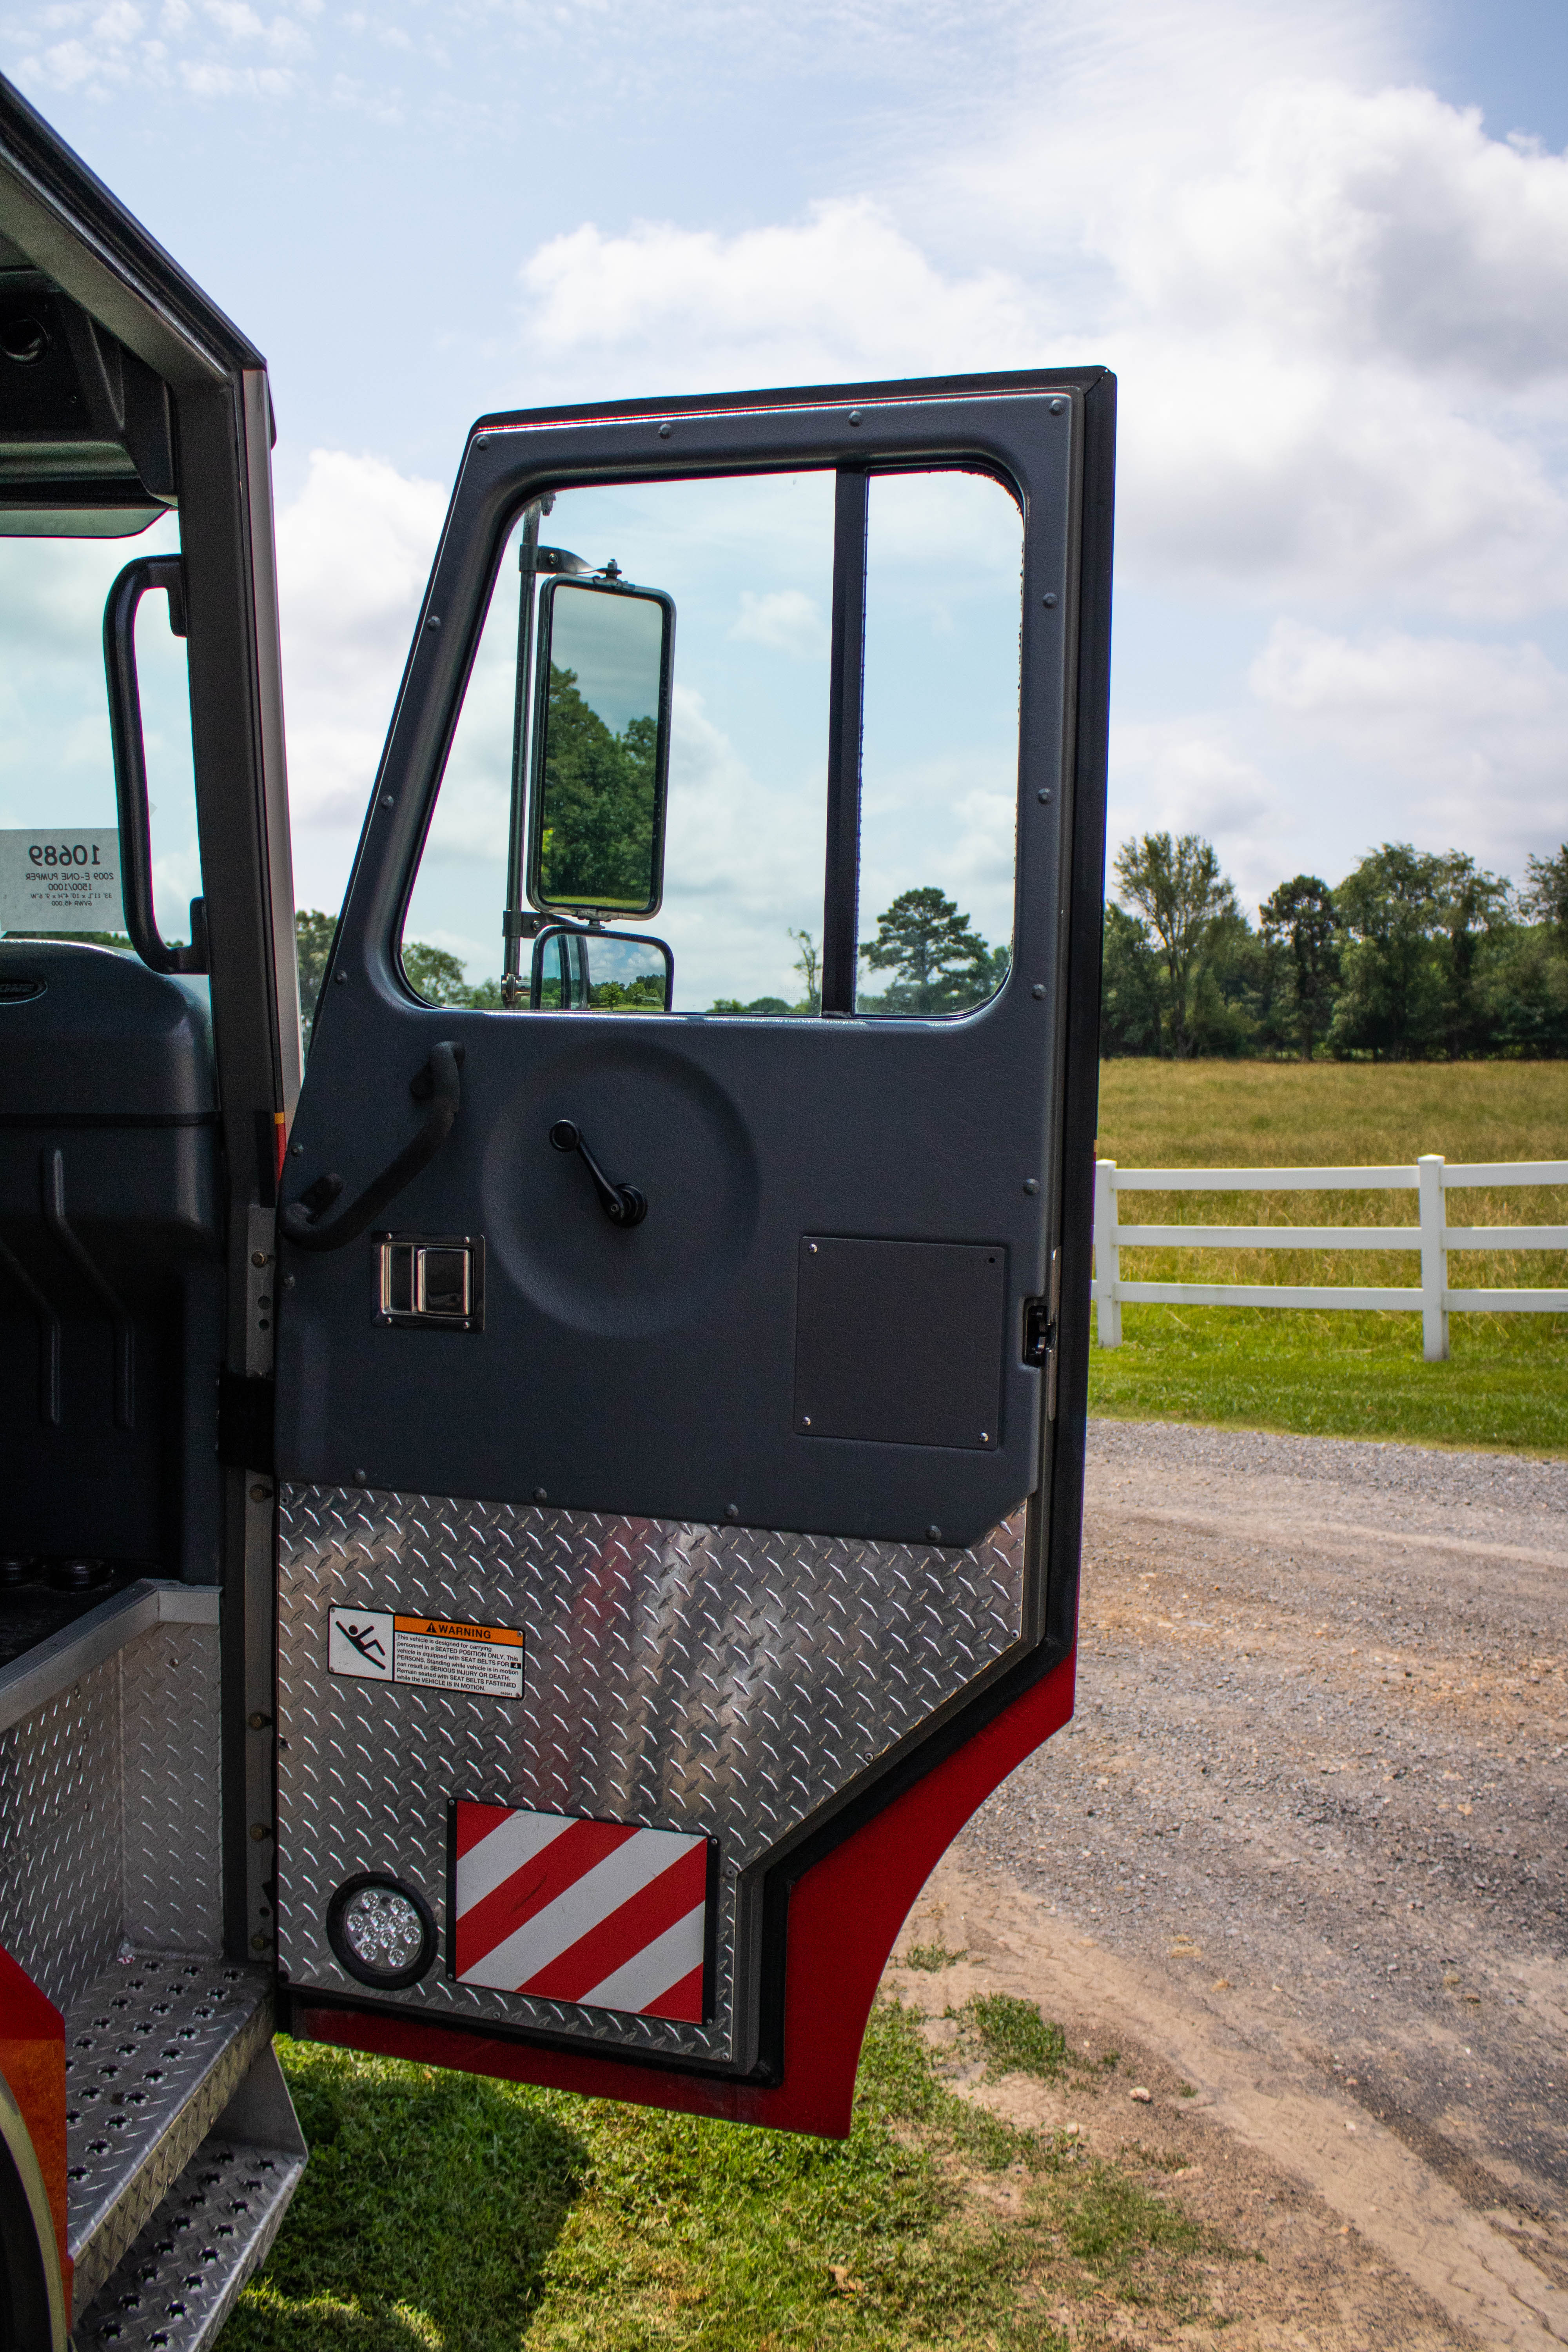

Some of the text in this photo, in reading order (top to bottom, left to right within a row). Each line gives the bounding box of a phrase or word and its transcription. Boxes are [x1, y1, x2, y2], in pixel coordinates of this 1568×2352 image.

[439, 1624, 491, 1639] WARNING
[397, 1655, 425, 1663] PERSONS.
[427, 1659, 450, 1667] Standing
